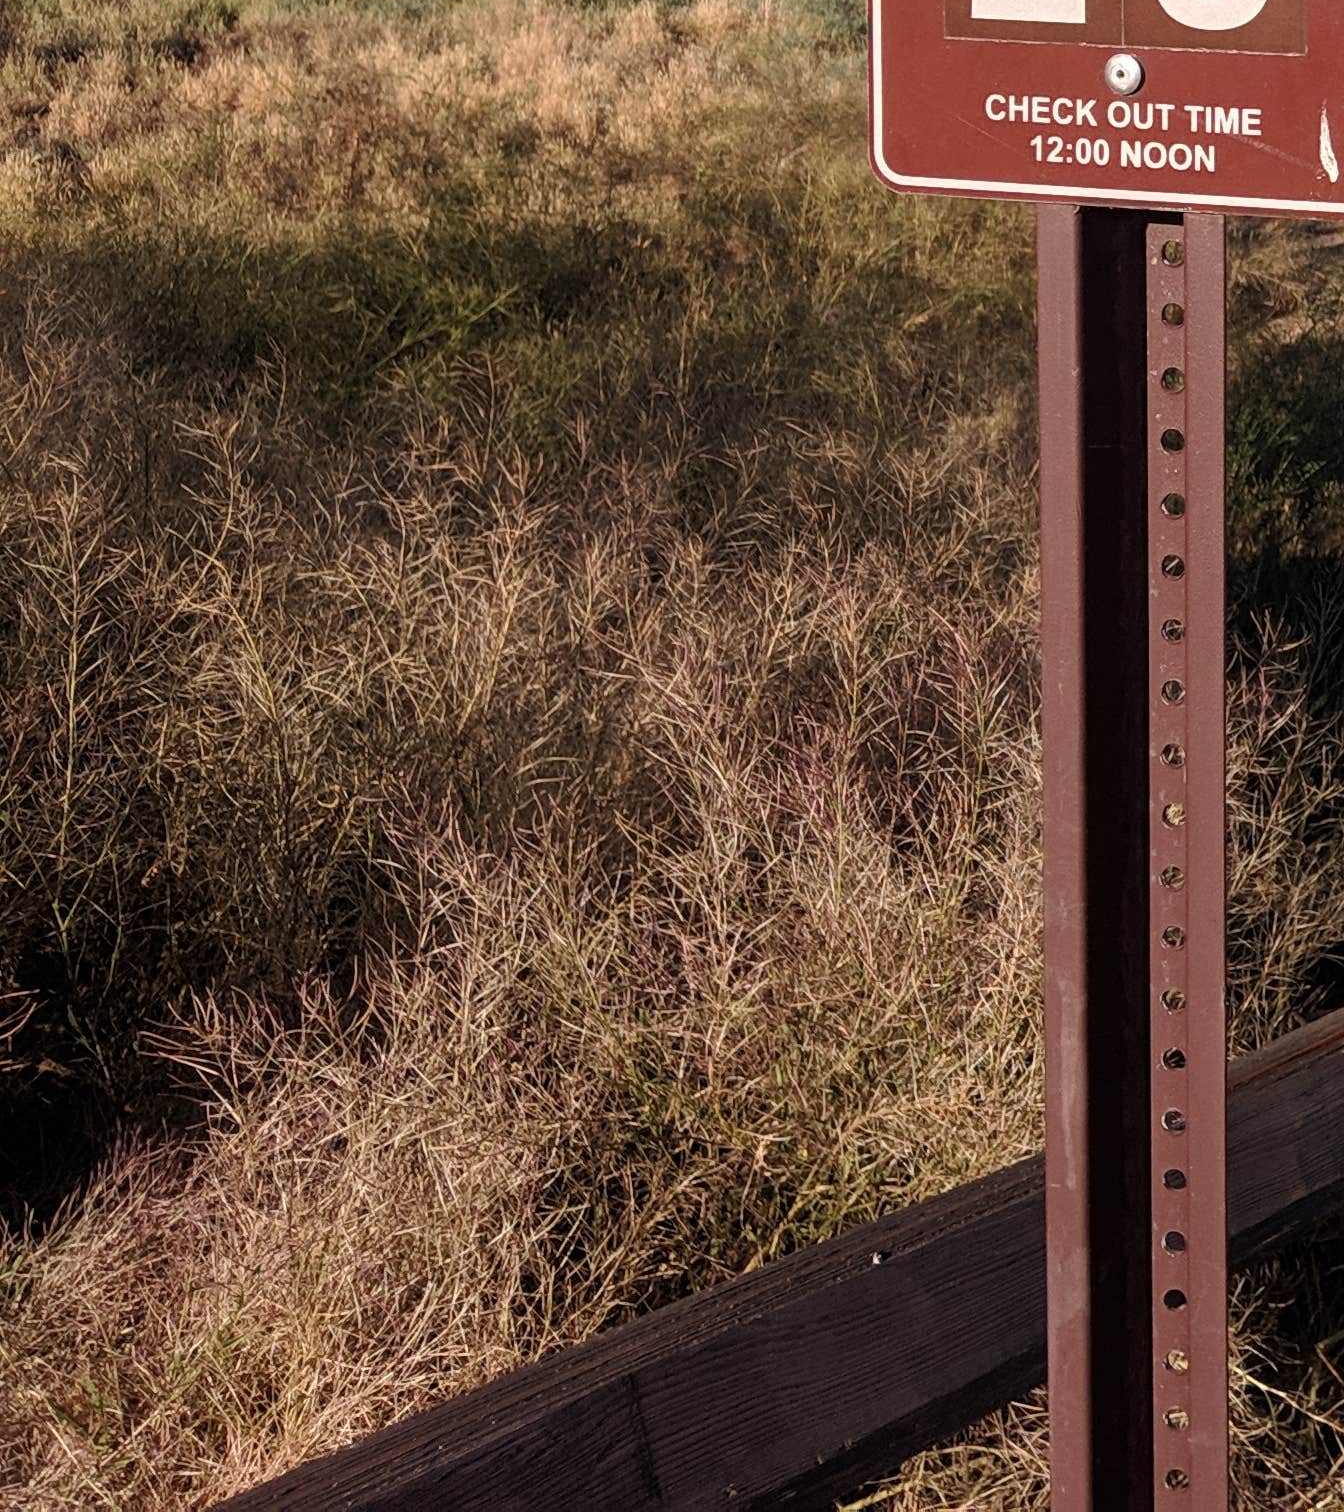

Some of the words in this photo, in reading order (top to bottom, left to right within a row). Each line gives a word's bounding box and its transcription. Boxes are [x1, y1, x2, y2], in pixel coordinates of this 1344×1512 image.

[985, 93, 1098, 127] CHECK
[1107, 100, 1176, 131] OUT
[1183, 105, 1262, 136] TIME
[1030, 135, 1110, 166] 12:00
[1120, 140, 1215, 173] NOON
